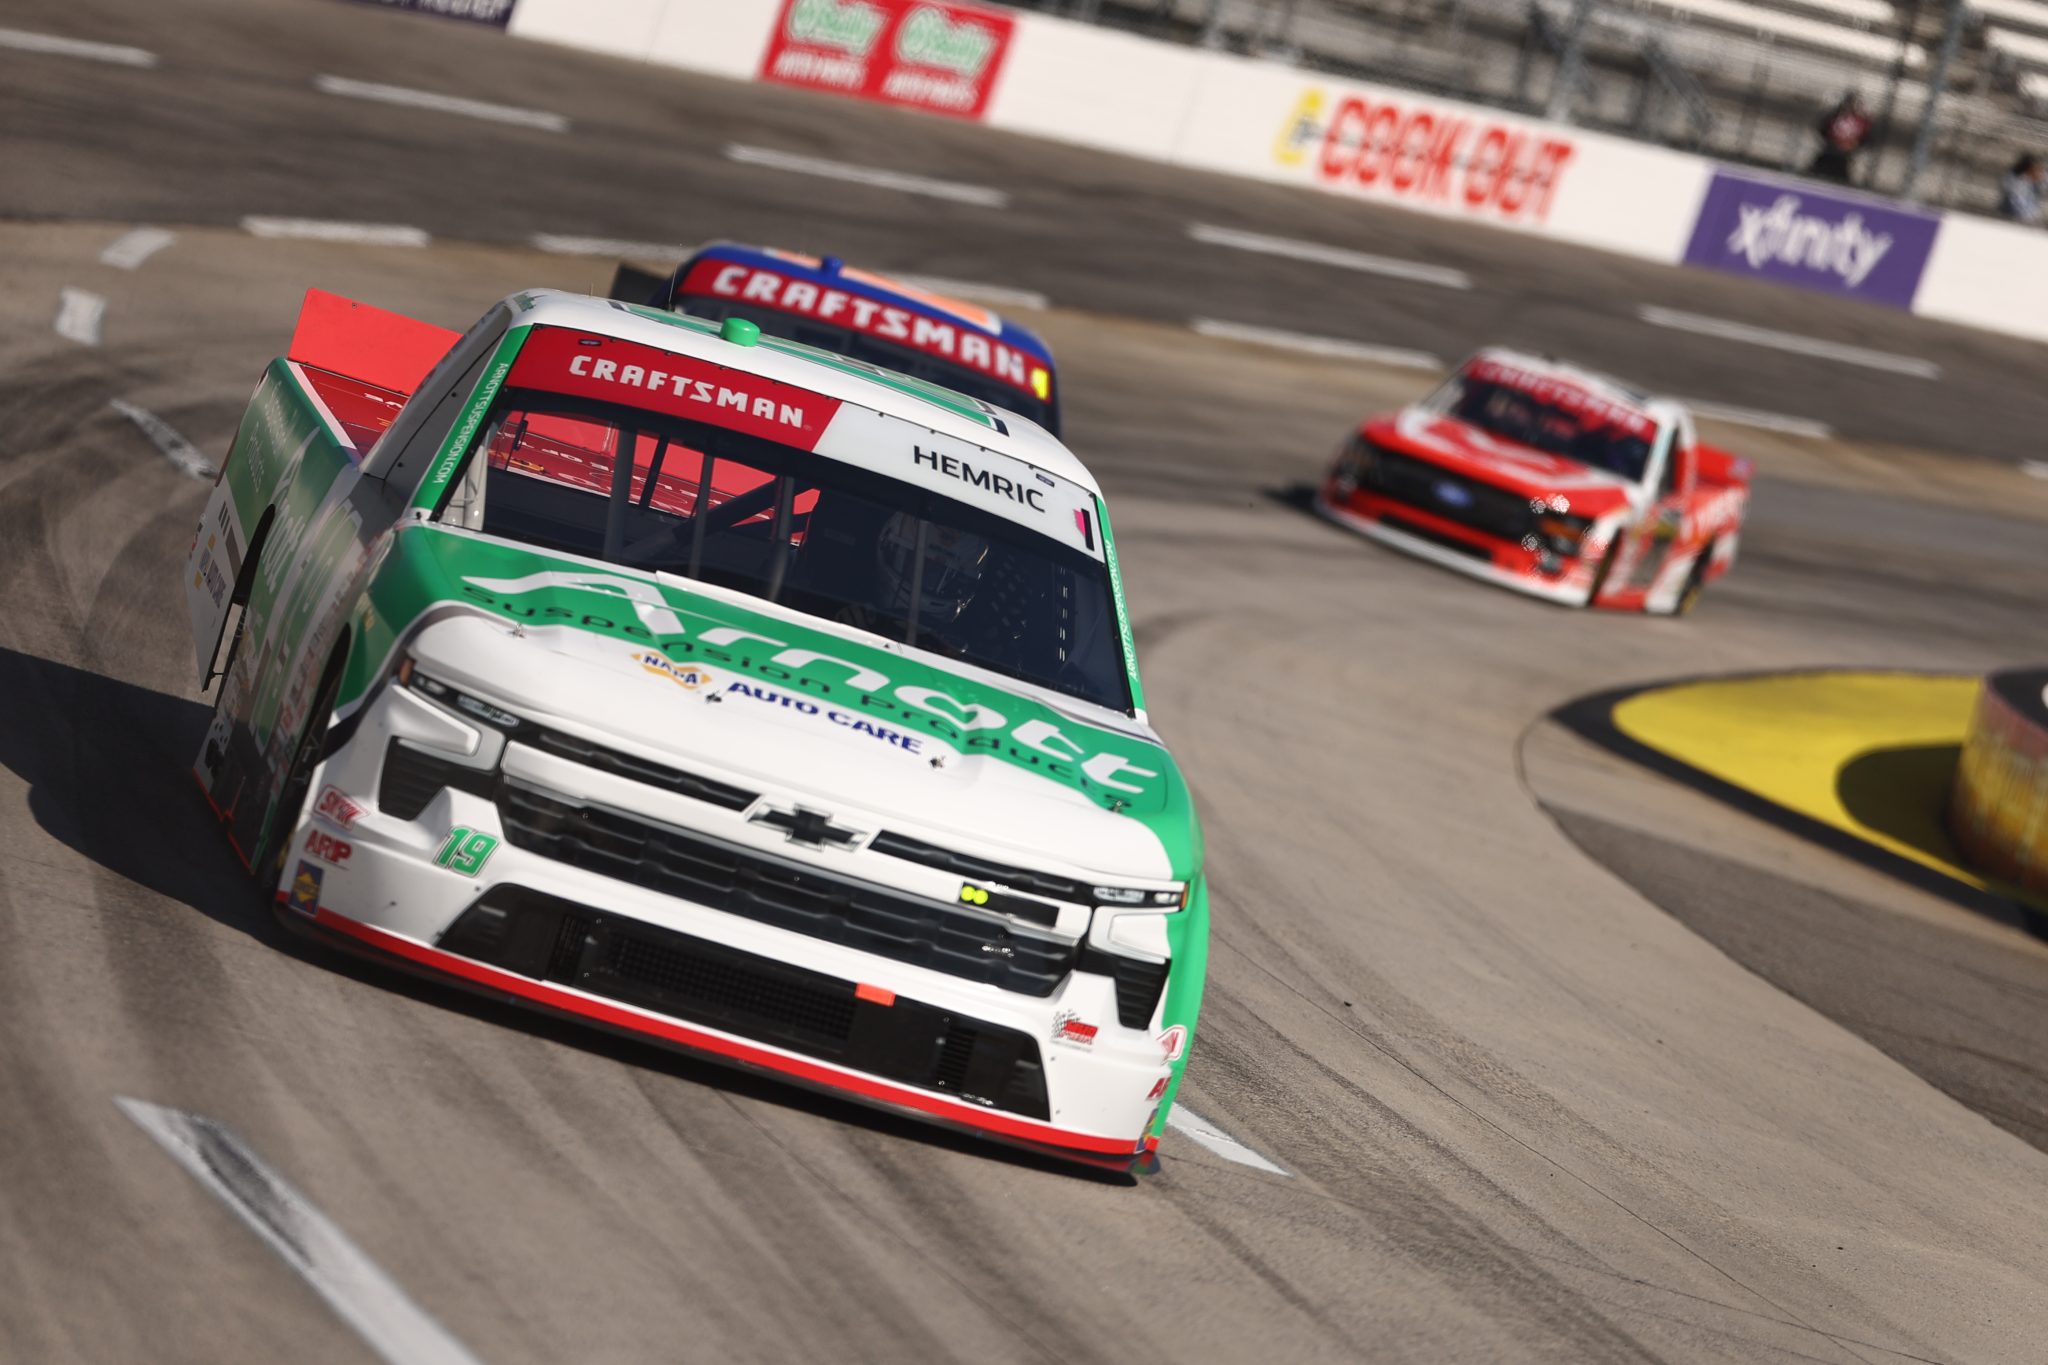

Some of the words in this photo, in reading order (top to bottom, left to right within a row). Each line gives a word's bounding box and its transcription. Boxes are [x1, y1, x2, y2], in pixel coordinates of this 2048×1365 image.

[1318, 95, 1474, 201] COOK
[1463, 123, 1577, 224] OUT
[1726, 194, 1894, 289] xfinity
[712, 265, 1026, 386] CRAFTSMAN
[569, 355, 804, 429] CRAFTSMAN
[913, 445, 1045, 513] HEMRIC
[727, 682, 819, 715] AUTO
[828, 711, 924, 755] CARE
[432, 825, 500, 877] 19
